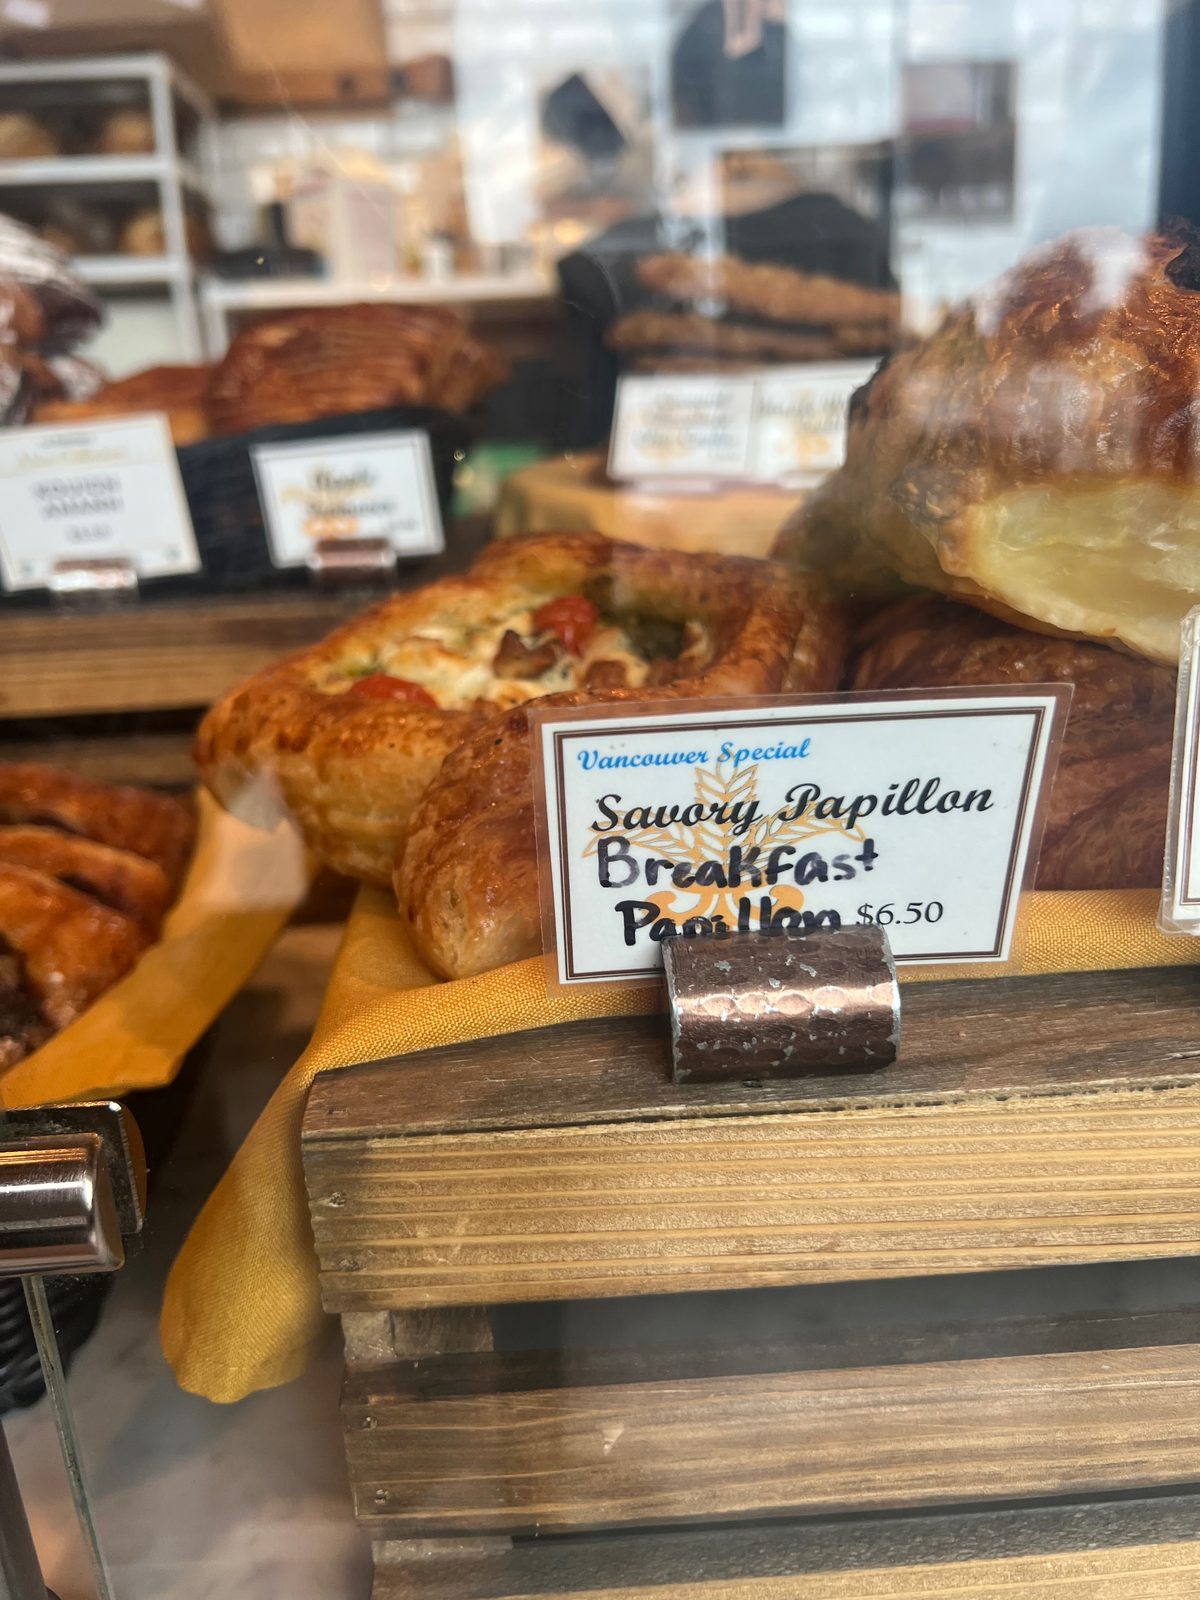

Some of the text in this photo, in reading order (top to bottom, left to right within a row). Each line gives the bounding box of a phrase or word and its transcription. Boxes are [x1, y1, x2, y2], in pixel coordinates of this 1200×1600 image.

[577, 737, 811, 770] Vancouver Special
[591, 777, 994, 836] Savory Papillon
[856, 901, 944, 926] $6.50
